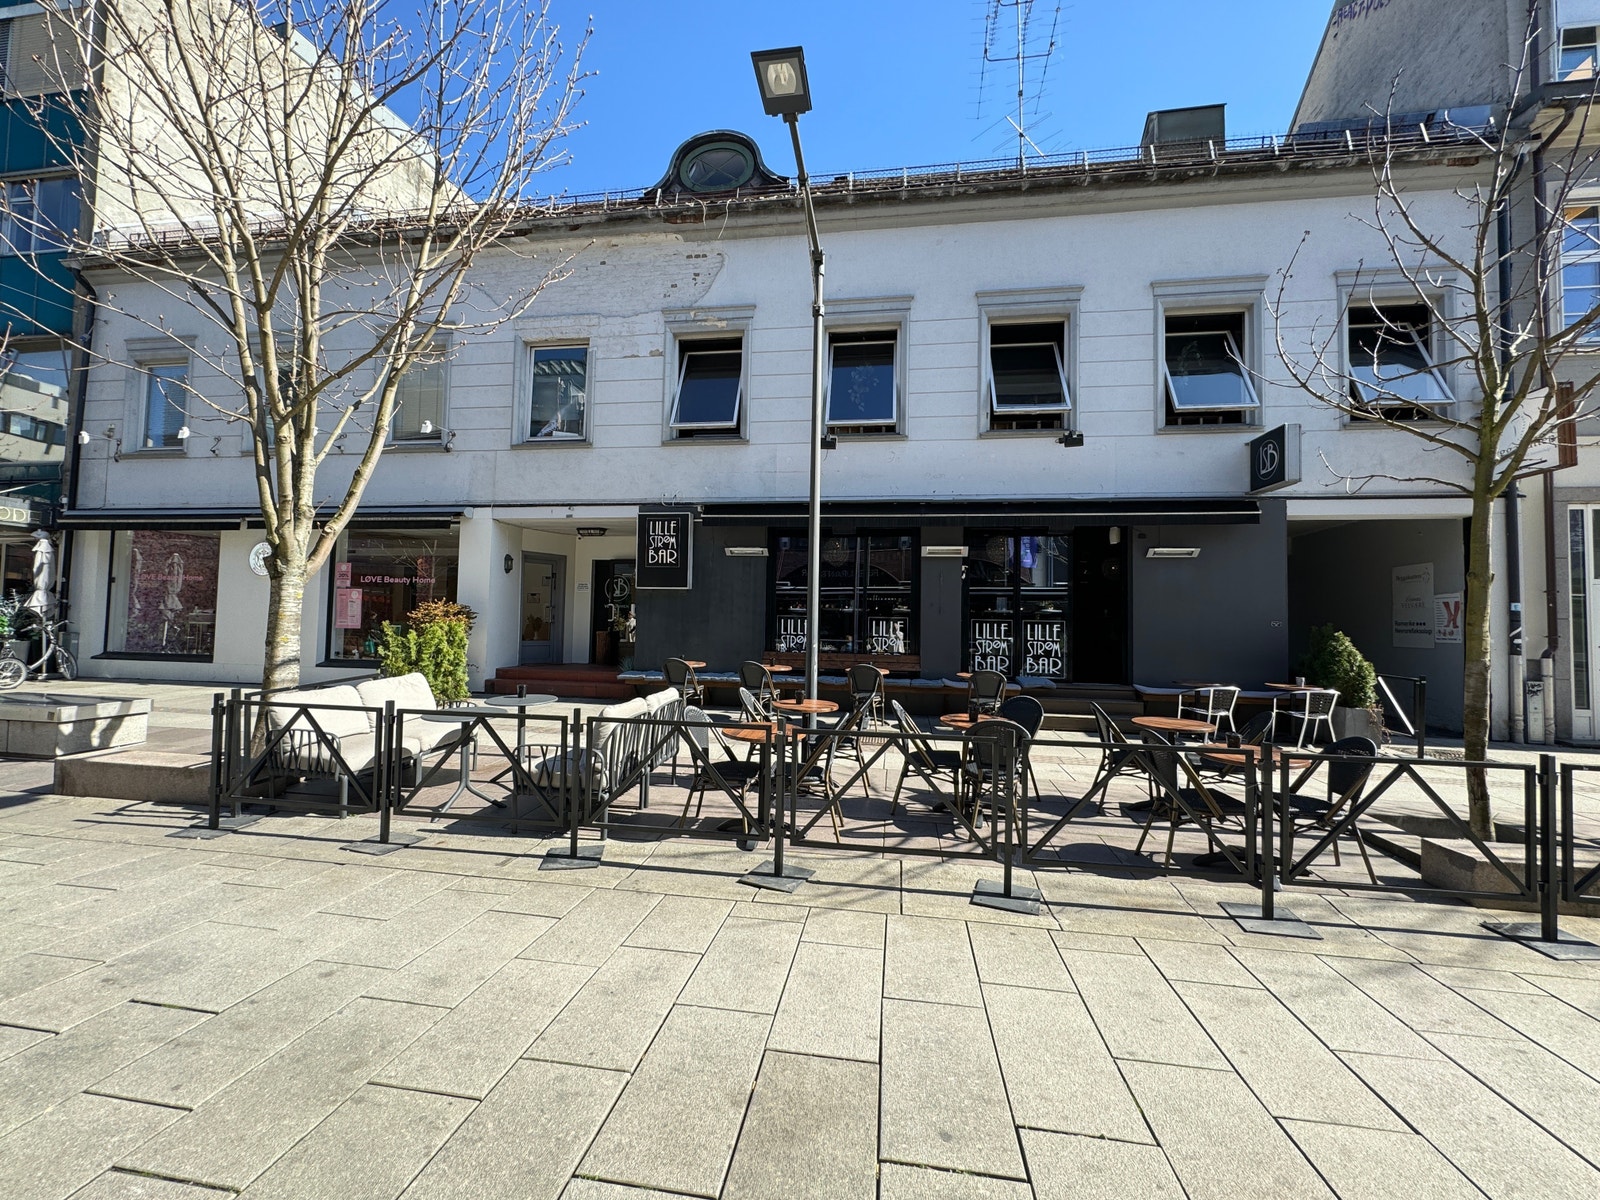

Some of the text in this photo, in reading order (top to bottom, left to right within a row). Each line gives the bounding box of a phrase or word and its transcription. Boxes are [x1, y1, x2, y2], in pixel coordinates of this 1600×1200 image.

[649, 521, 676, 535] LILLE
[649, 535, 676, 549] STRØM
[648, 549, 677, 564] BAR
[384, 576, 411, 585] Beauty
[872, 620, 903, 637] LILLE
[976, 623, 1008, 639] LILLE
[1027, 624, 1060, 641] LILLE
[976, 640, 1008, 655] STRØM
[1026, 641, 1061, 657] STRØM
[975, 656, 1009, 672] BAR
[1027, 657, 1061, 674] BAR
